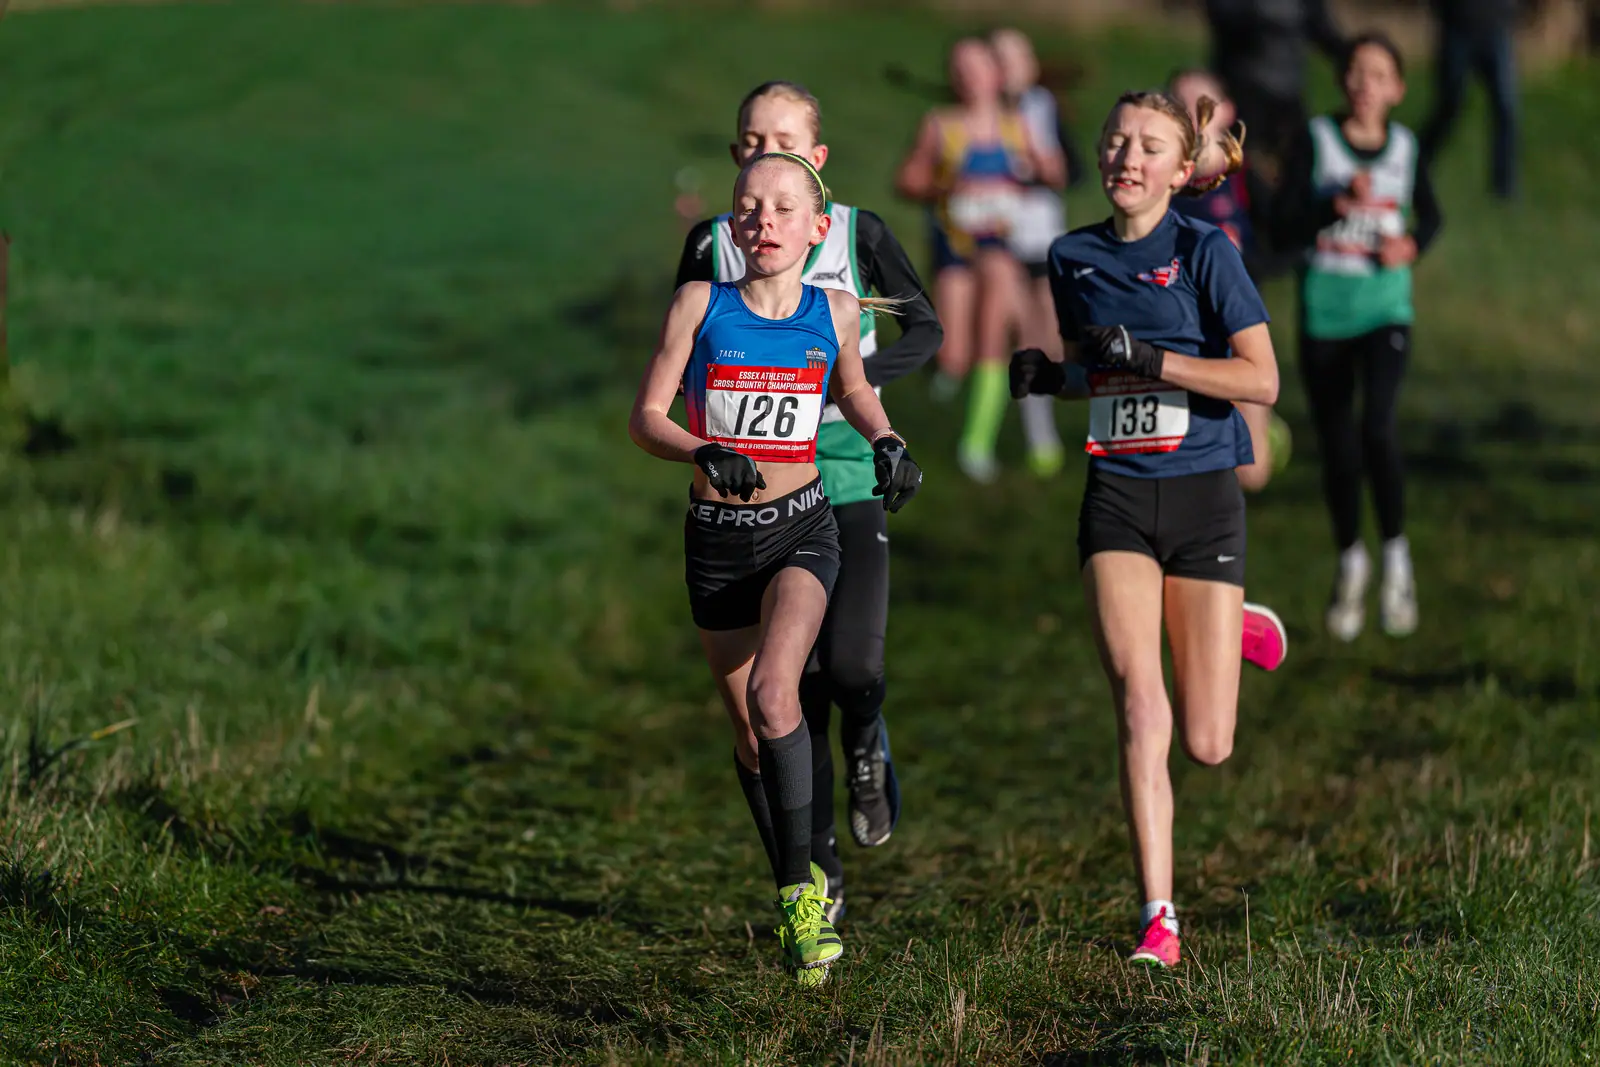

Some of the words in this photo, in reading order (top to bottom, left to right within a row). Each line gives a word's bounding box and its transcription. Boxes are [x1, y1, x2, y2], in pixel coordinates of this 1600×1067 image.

[719, 350, 746, 359] TACTIC
[738, 371, 760, 380] ESSEX
[760, 372, 796, 382] ATHLETICS
[713, 379, 735, 388] CROSS
[735, 381, 766, 390] COUNTRY
[766, 381, 818, 391] CHAMPIONSHIPS
[734, 394, 799, 438] 126
[1111, 395, 1159, 437] 133
[717, 507, 778, 527] PRO
